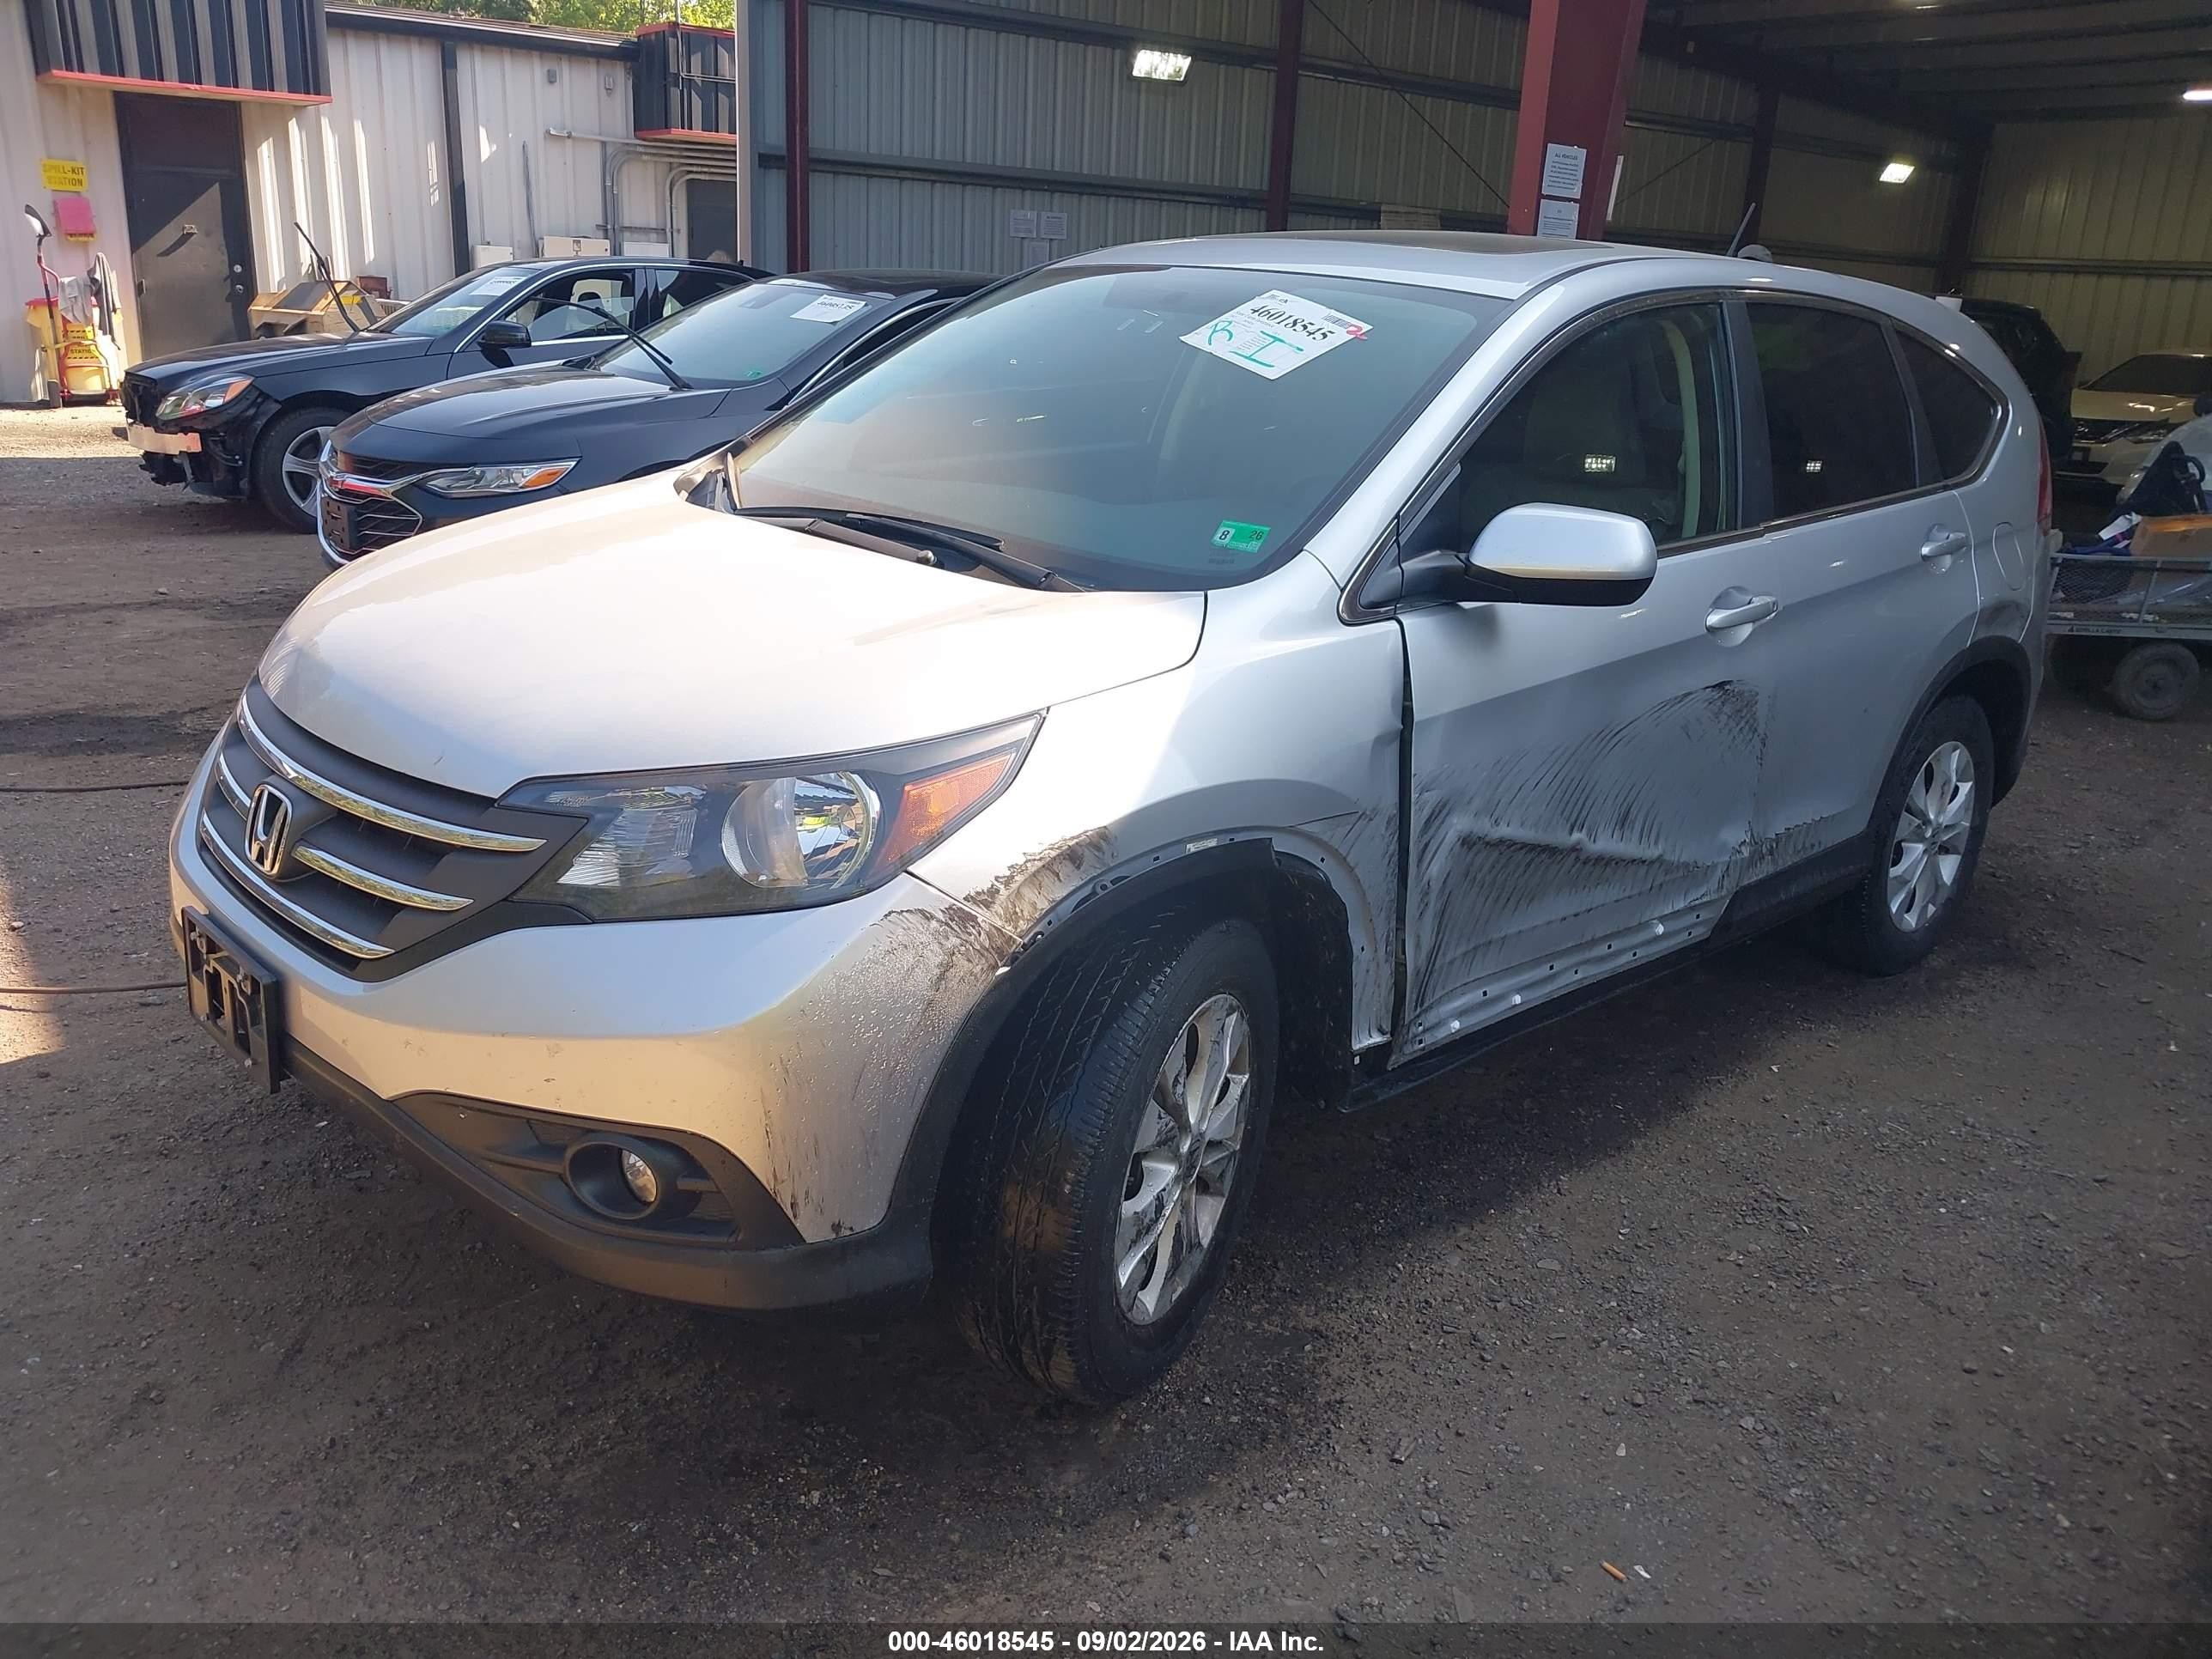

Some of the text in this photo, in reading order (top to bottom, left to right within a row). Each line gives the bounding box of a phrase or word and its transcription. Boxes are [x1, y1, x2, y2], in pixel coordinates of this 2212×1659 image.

[46, 175, 84, 187] STATION
[1250, 304, 1337, 342] 46018545
[1218, 529, 1265, 541] 8 26
